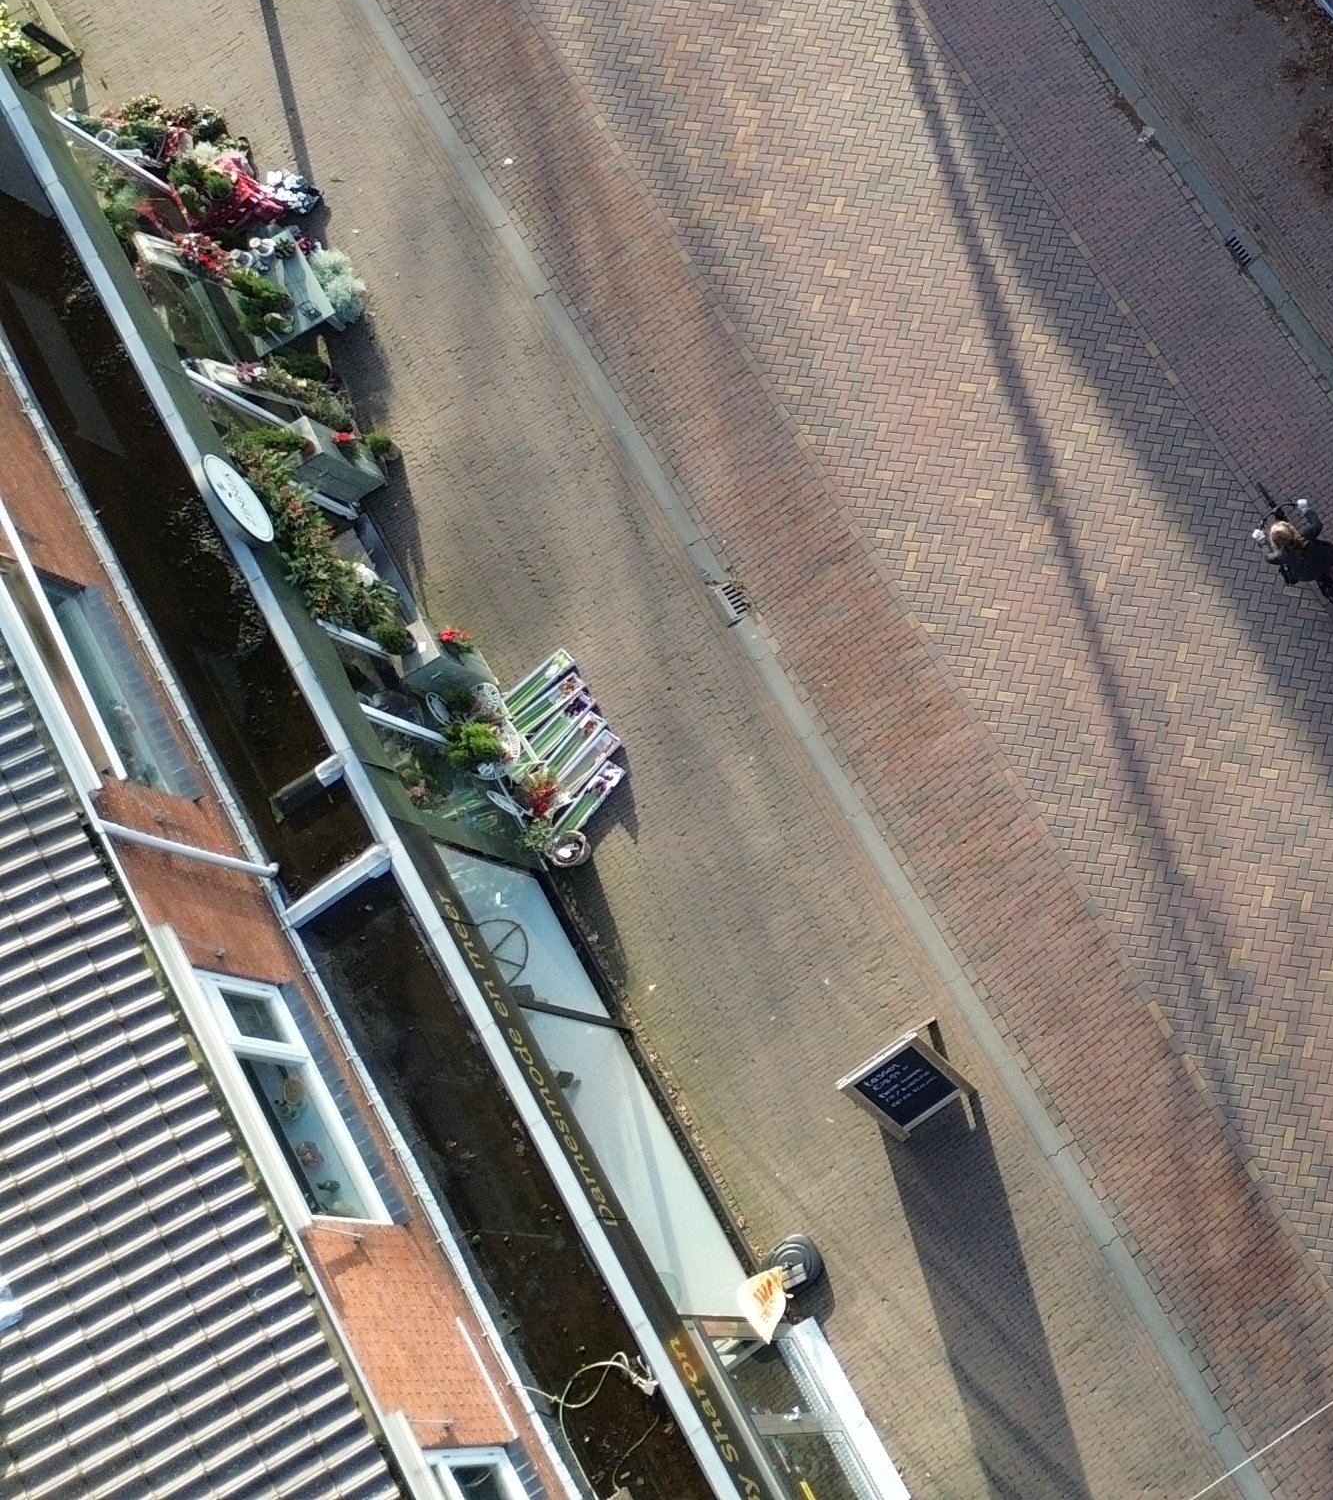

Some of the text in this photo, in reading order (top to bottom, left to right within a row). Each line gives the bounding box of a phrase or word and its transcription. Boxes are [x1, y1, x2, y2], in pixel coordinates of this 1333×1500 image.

[438, 891, 616, 1227] Damesmode en meer
[670, 1338, 760, 1500] y Sharon
